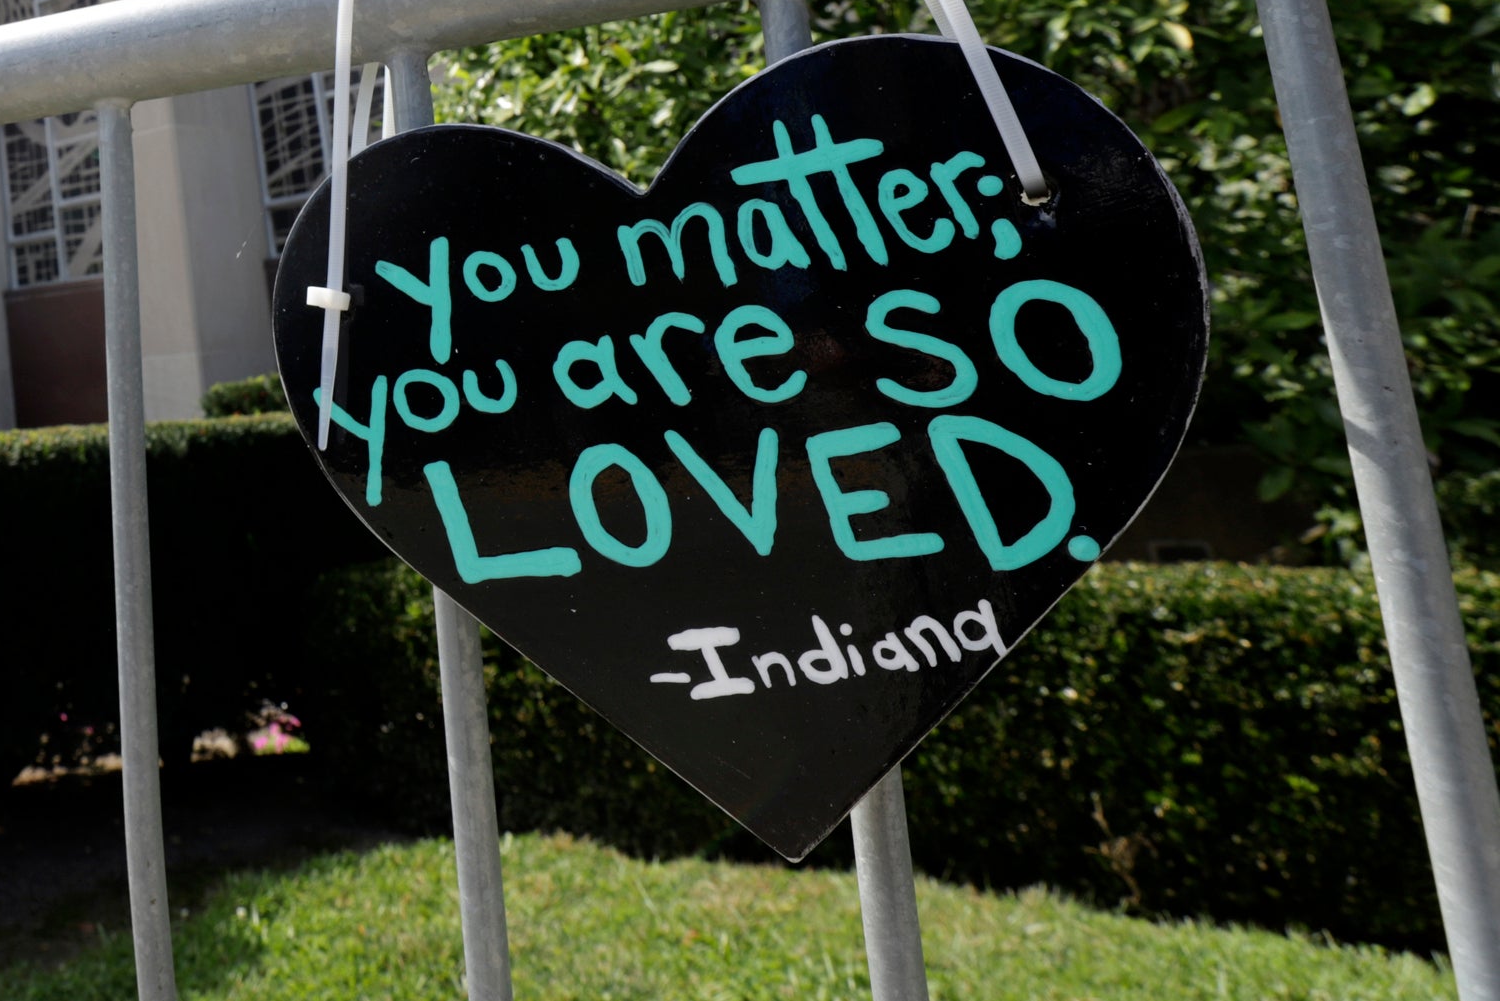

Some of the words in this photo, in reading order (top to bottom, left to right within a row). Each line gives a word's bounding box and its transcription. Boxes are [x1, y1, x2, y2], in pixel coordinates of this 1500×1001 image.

[617, 113, 1023, 288] matter;
[552, 303, 808, 407] are
[865, 278, 1123, 407] SO
[422, 414, 1100, 585] LOVED.
